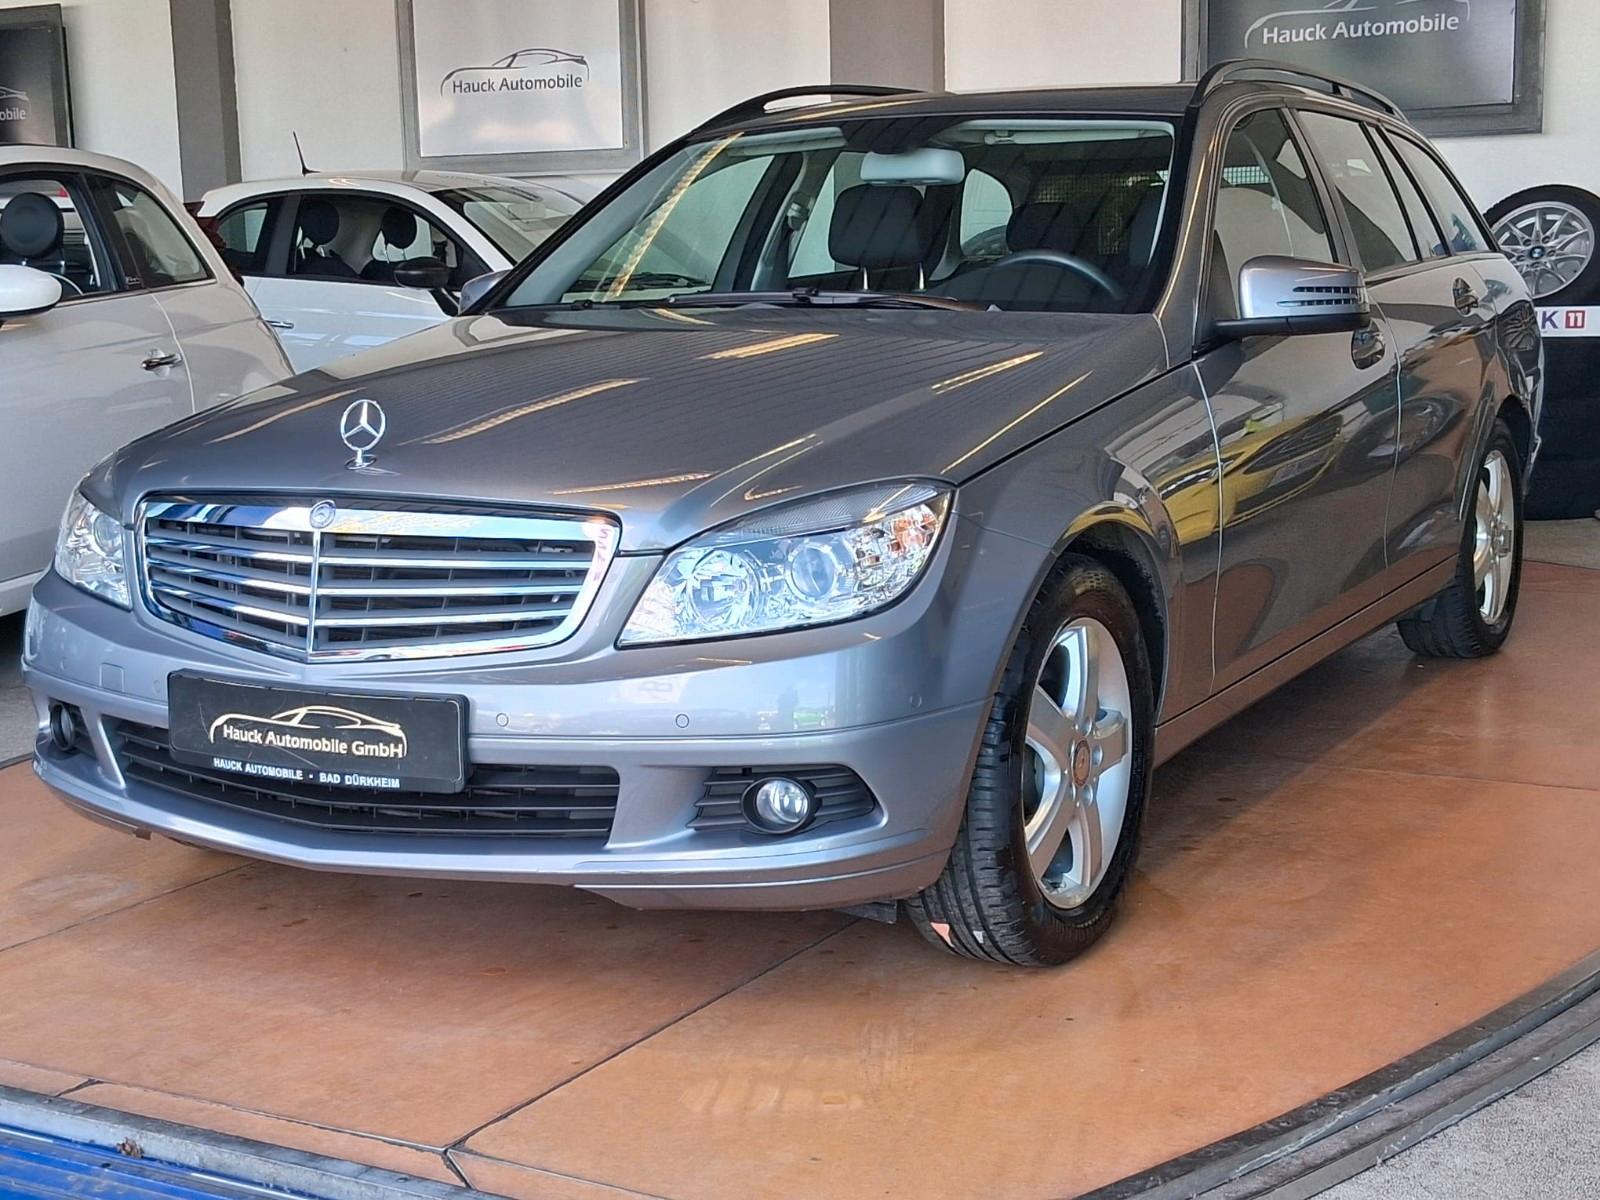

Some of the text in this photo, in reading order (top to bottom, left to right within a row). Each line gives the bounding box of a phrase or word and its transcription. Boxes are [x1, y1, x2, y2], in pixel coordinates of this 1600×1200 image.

[1262, 13, 1460, 45] Hauck Automobile
[452, 73, 583, 94] Hauck Automobile
[1536, 310, 1584, 329] K 11
[223, 724, 403, 758] Hauck Automobile GmbH
[213, 758, 400, 788] HAUCK AUTOMOBILE BAD DÜRKHEIM
